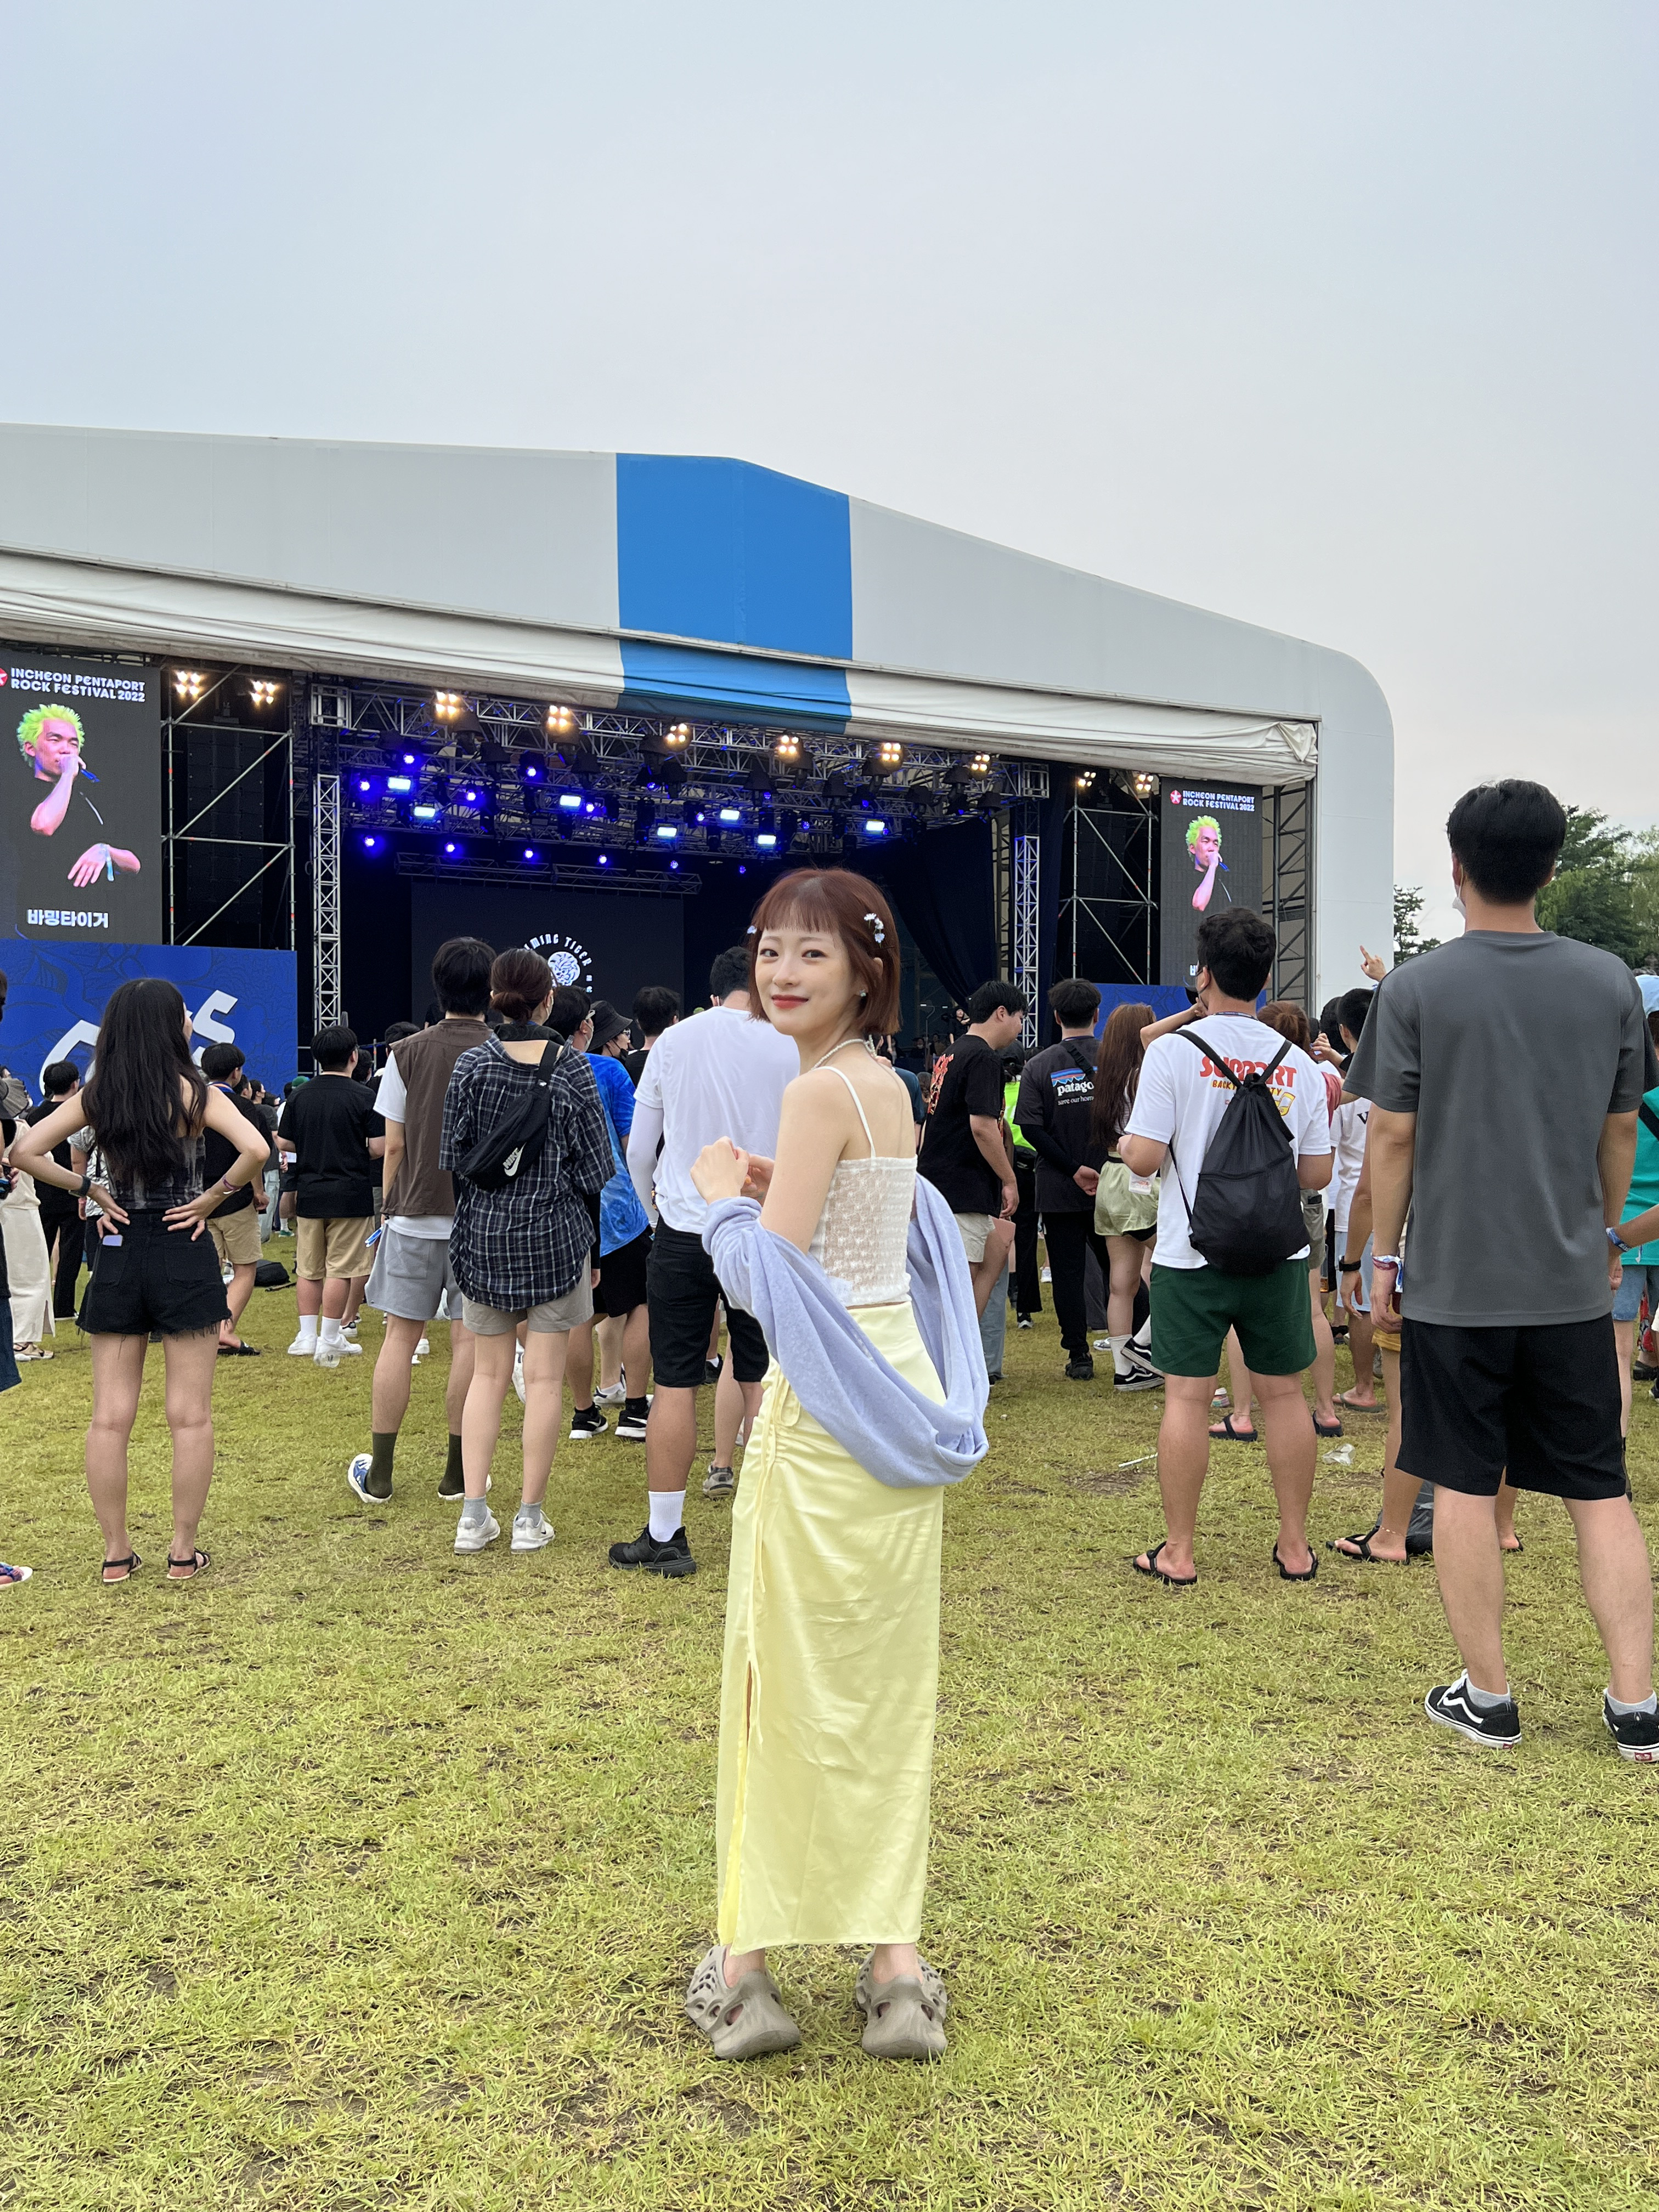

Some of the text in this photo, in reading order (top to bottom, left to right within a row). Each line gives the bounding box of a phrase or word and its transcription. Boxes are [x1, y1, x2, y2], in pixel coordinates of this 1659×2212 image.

[11, 668, 145, 691] INCHEON PENTAPORT
[11, 679, 145, 702] ROCK FESTIVAL 2022
[1182, 790, 1255, 804] INCHEON PENTAPORT
[1182, 798, 1204, 807] ROCK
[1205, 800, 1239, 810] FESTIVAL
[27, 909, 109, 928] 바밍타이거
[1057, 1081, 1094, 1096] patago
[503, 1147, 519, 1169] NIKE
